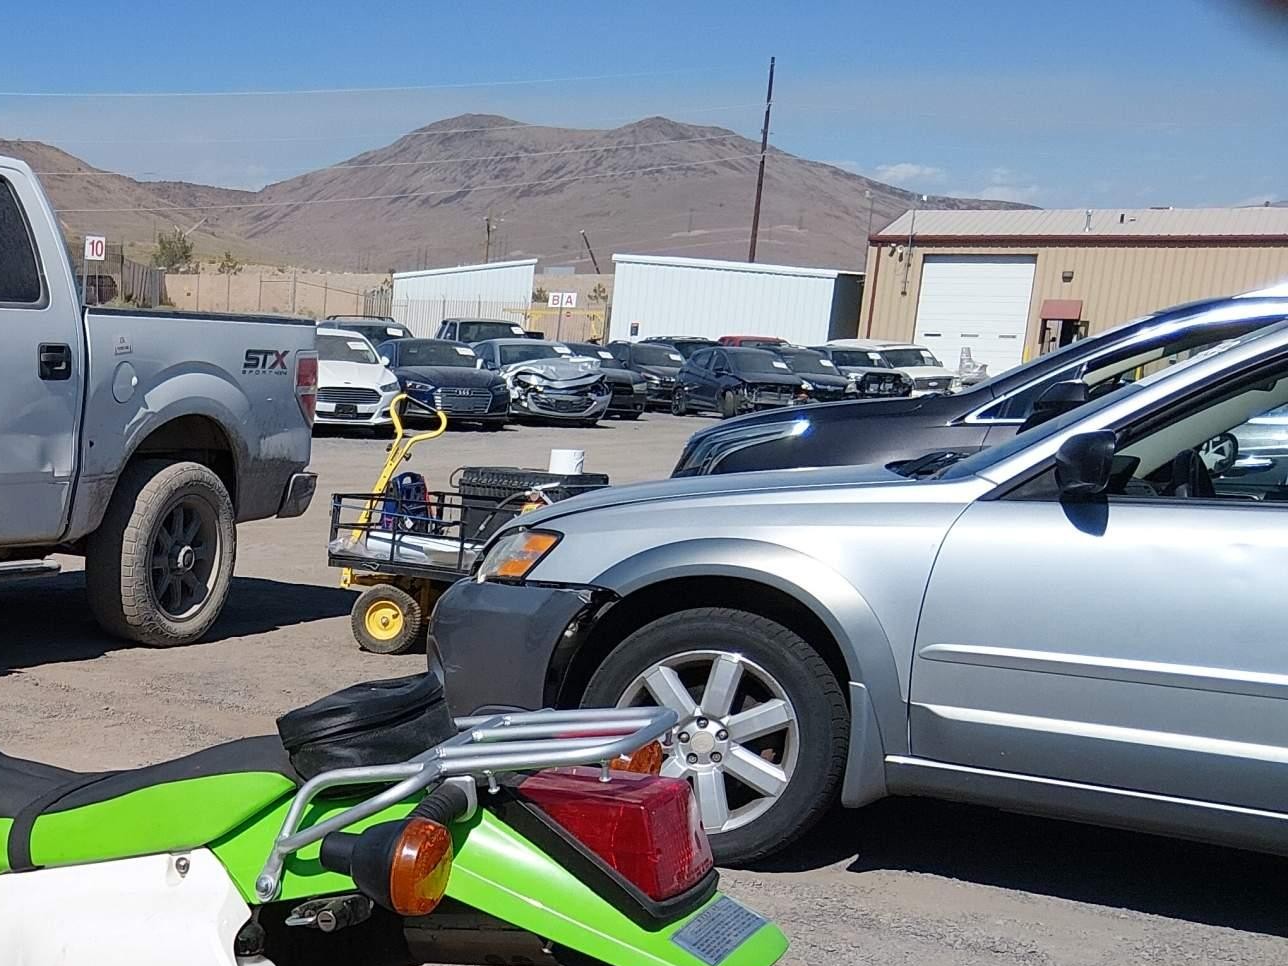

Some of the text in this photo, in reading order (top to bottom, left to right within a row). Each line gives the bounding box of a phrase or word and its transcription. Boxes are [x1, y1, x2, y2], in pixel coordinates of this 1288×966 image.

[89, 240, 104, 257] 10
[552, 295, 560, 306] B
[565, 295, 573, 305] A
[243, 349, 290, 370] STX
